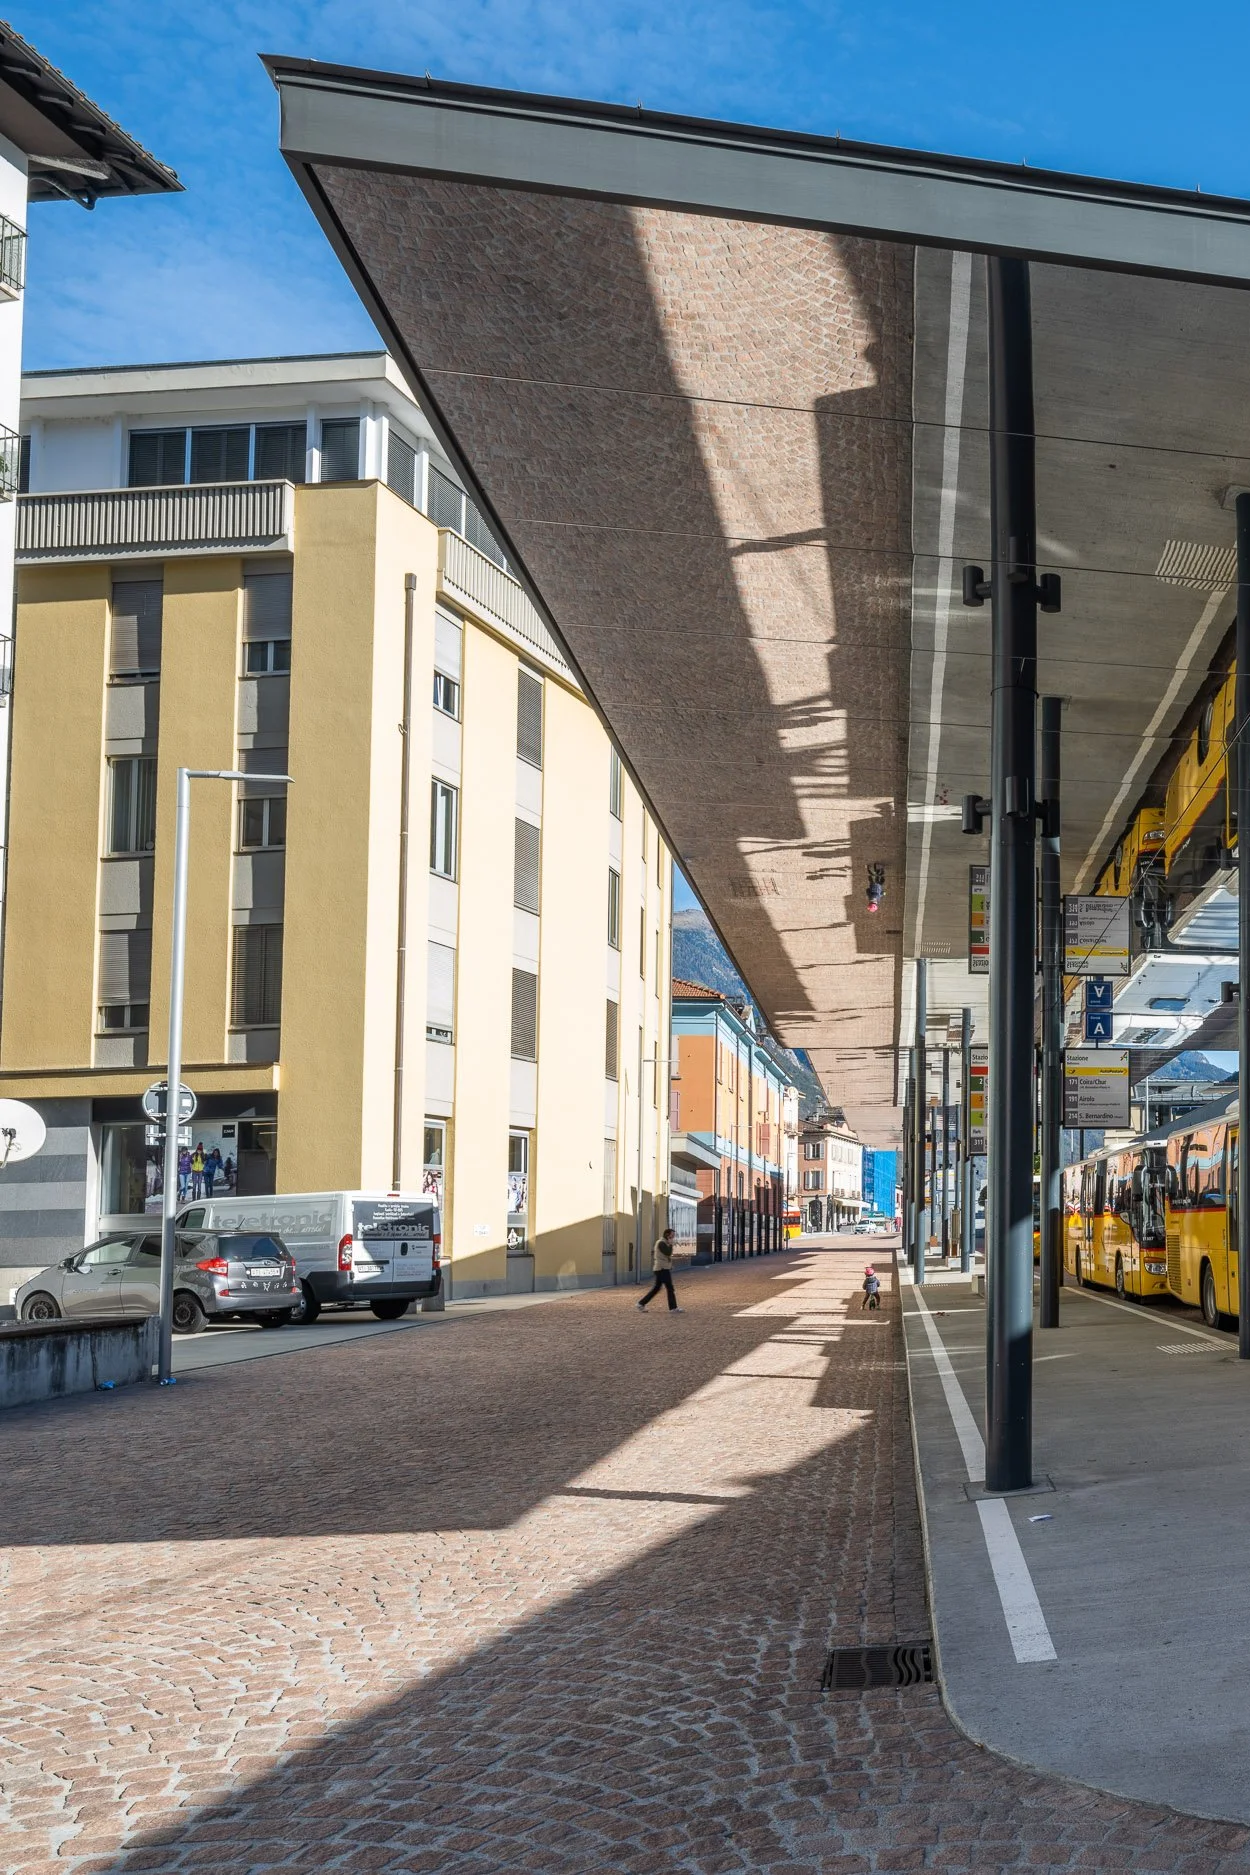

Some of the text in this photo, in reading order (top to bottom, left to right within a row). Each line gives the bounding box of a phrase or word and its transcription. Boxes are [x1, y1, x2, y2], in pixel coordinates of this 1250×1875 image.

[1093, 1022, 1105, 1035] A
[1066, 1054, 1089, 1062] Stazione
[212, 1210, 333, 1229] teletronic
[357, 1222, 430, 1232] teletronic
